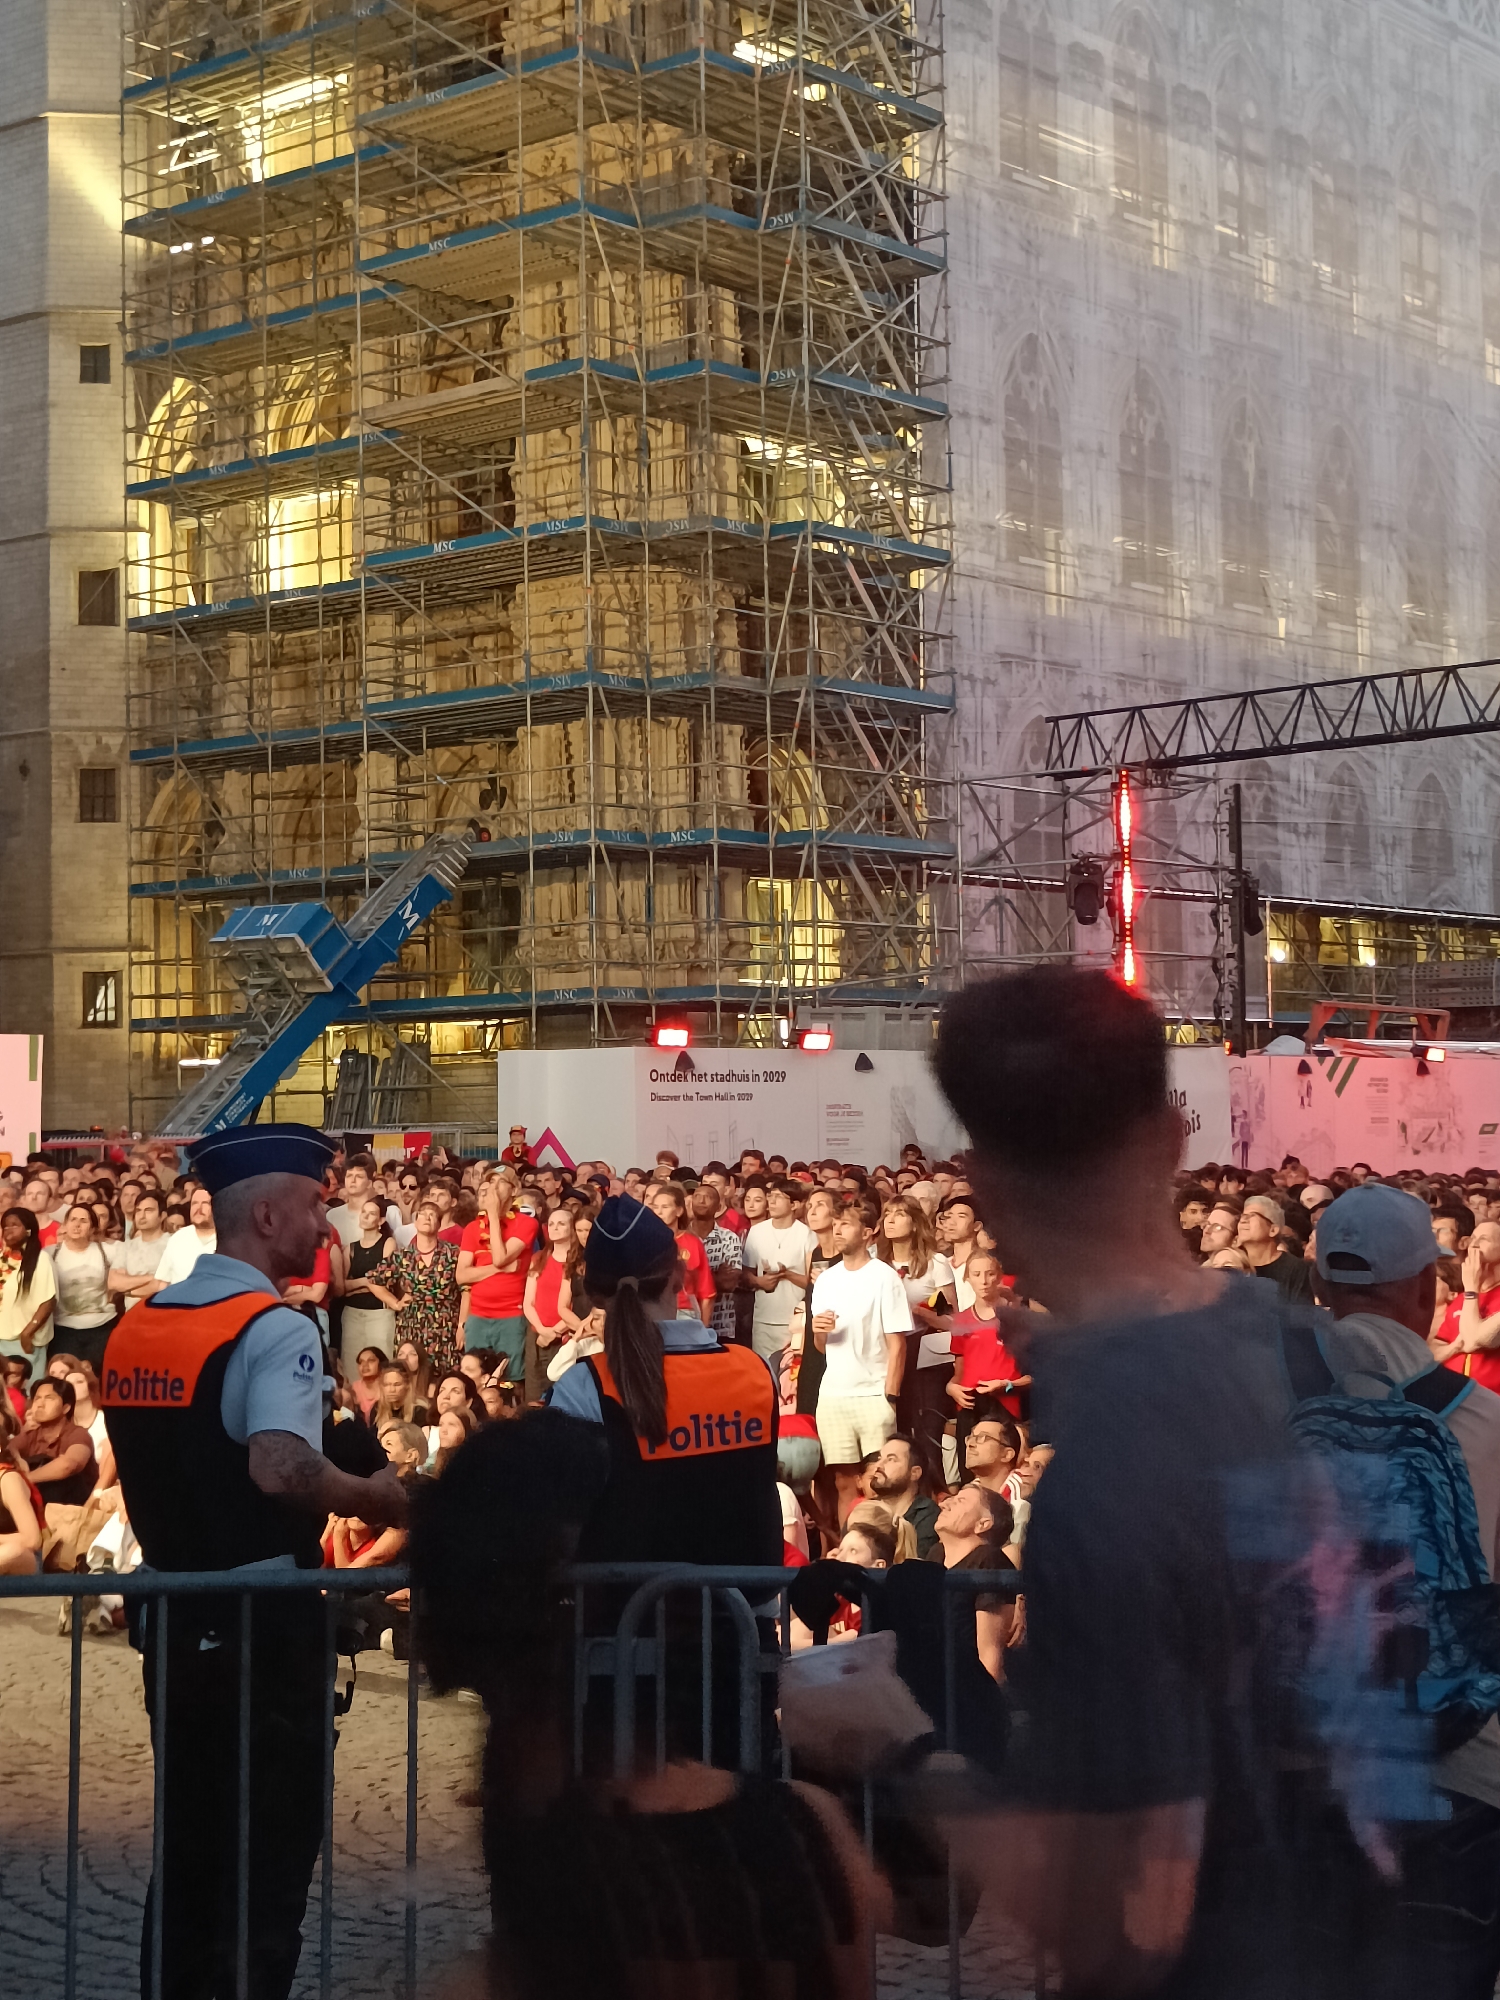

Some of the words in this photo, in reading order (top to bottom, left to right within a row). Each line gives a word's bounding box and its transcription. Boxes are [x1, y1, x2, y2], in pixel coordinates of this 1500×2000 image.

[425, 88, 446, 104] MSC
[768, 211, 794, 227] MSC
[429, 238, 451, 252] MSC
[210, 464, 229, 475] MSC
[546, 519, 569, 531] MSC
[727, 519, 748, 533] MSC
[433, 540, 456, 554] MSC
[873, 535, 892, 549] MSC
[210, 600, 230, 612] MSC
[608, 674, 630, 688] MSC
[611, 830, 634, 842] MSC
[670, 830, 695, 843] MSC
[289, 868, 310, 879] MSC
[214, 876, 234, 886] MSC
[399, 899, 420, 930] M
[553, 988, 578, 1000] MSC
[649, 1069, 689, 1083] Ontdek
[691, 1070, 708, 1083] het
[710, 1070, 750, 1083] stadhuis
[751, 1069, 761, 1083] in
[762, 1070, 787, 1083] 2029
[650, 1092, 681, 1102] Discover
[682, 1092, 694, 1102] the
[695, 1091, 714, 1102] Town
[714, 1091, 729, 1102] Hall
[737, 1092, 754, 1101] 2029
[106, 1367, 185, 1401] Politie
[648, 1410, 763, 1454] olitie
